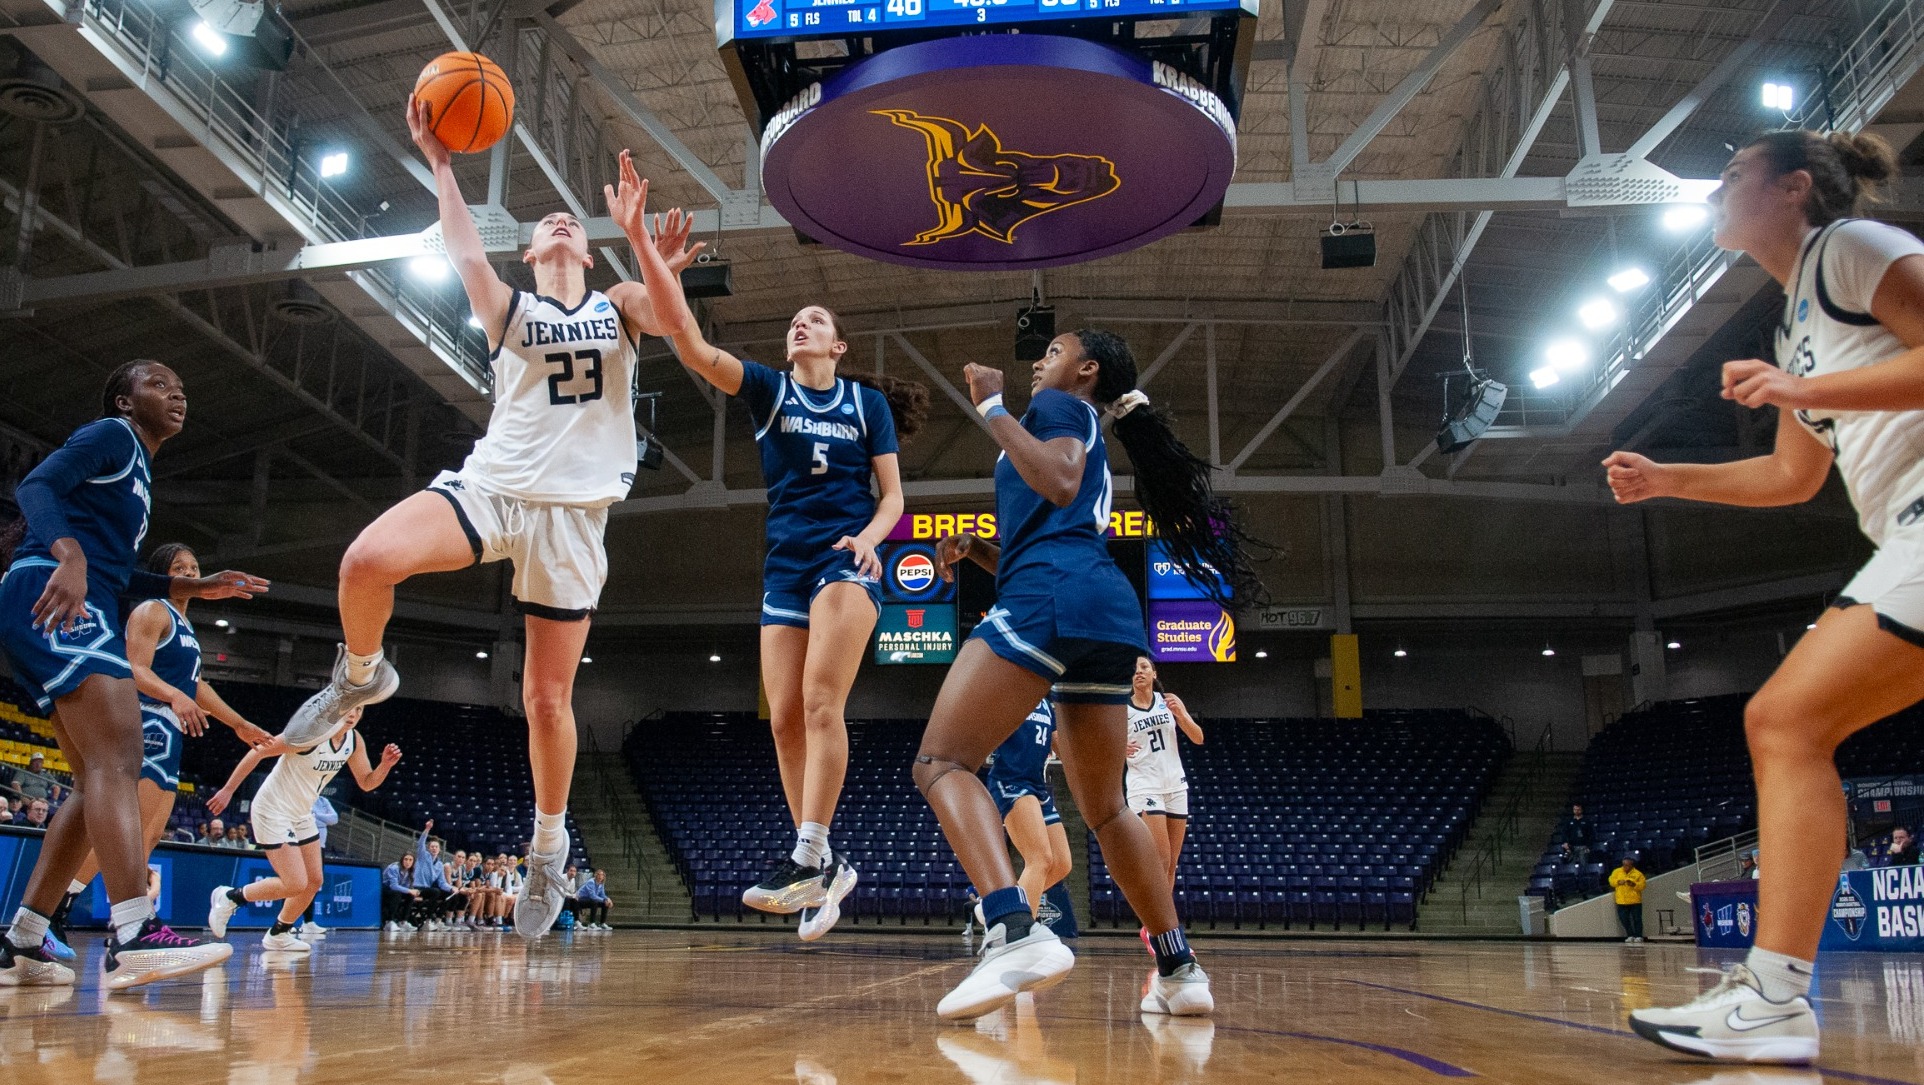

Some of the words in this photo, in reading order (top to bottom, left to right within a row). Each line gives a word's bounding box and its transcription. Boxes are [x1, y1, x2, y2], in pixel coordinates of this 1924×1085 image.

[790, 13, 799, 27] 5
[805, 12, 820, 25] FLS
[847, 9, 863, 23] TOL
[868, 8, 876, 22] 4
[976, 7, 986, 22] 3
[521, 317, 618, 348] JENNIES
[545, 349, 603, 406] 23
[780, 415, 860, 442] WASHBURN
[811, 442, 830, 475] 5
[913, 513, 997, 539] BRES
[900, 568, 932, 577] PEPSI
[1156, 620, 1212, 631] Graduate
[1261, 612, 1287, 624] HOT
[1288, 610, 1320, 626] 96.7
[878, 631, 953, 642] MASCHKA
[878, 642, 920, 651] PERSONAL
[923, 642, 953, 651] INJURY
[1157, 632, 1202, 643] Studies
[1133, 713, 1170, 734] JENNIES
[1035, 724, 1048, 747] 24
[1147, 728, 1166, 753] 21
[1872, 867, 1924, 901] NCAA
